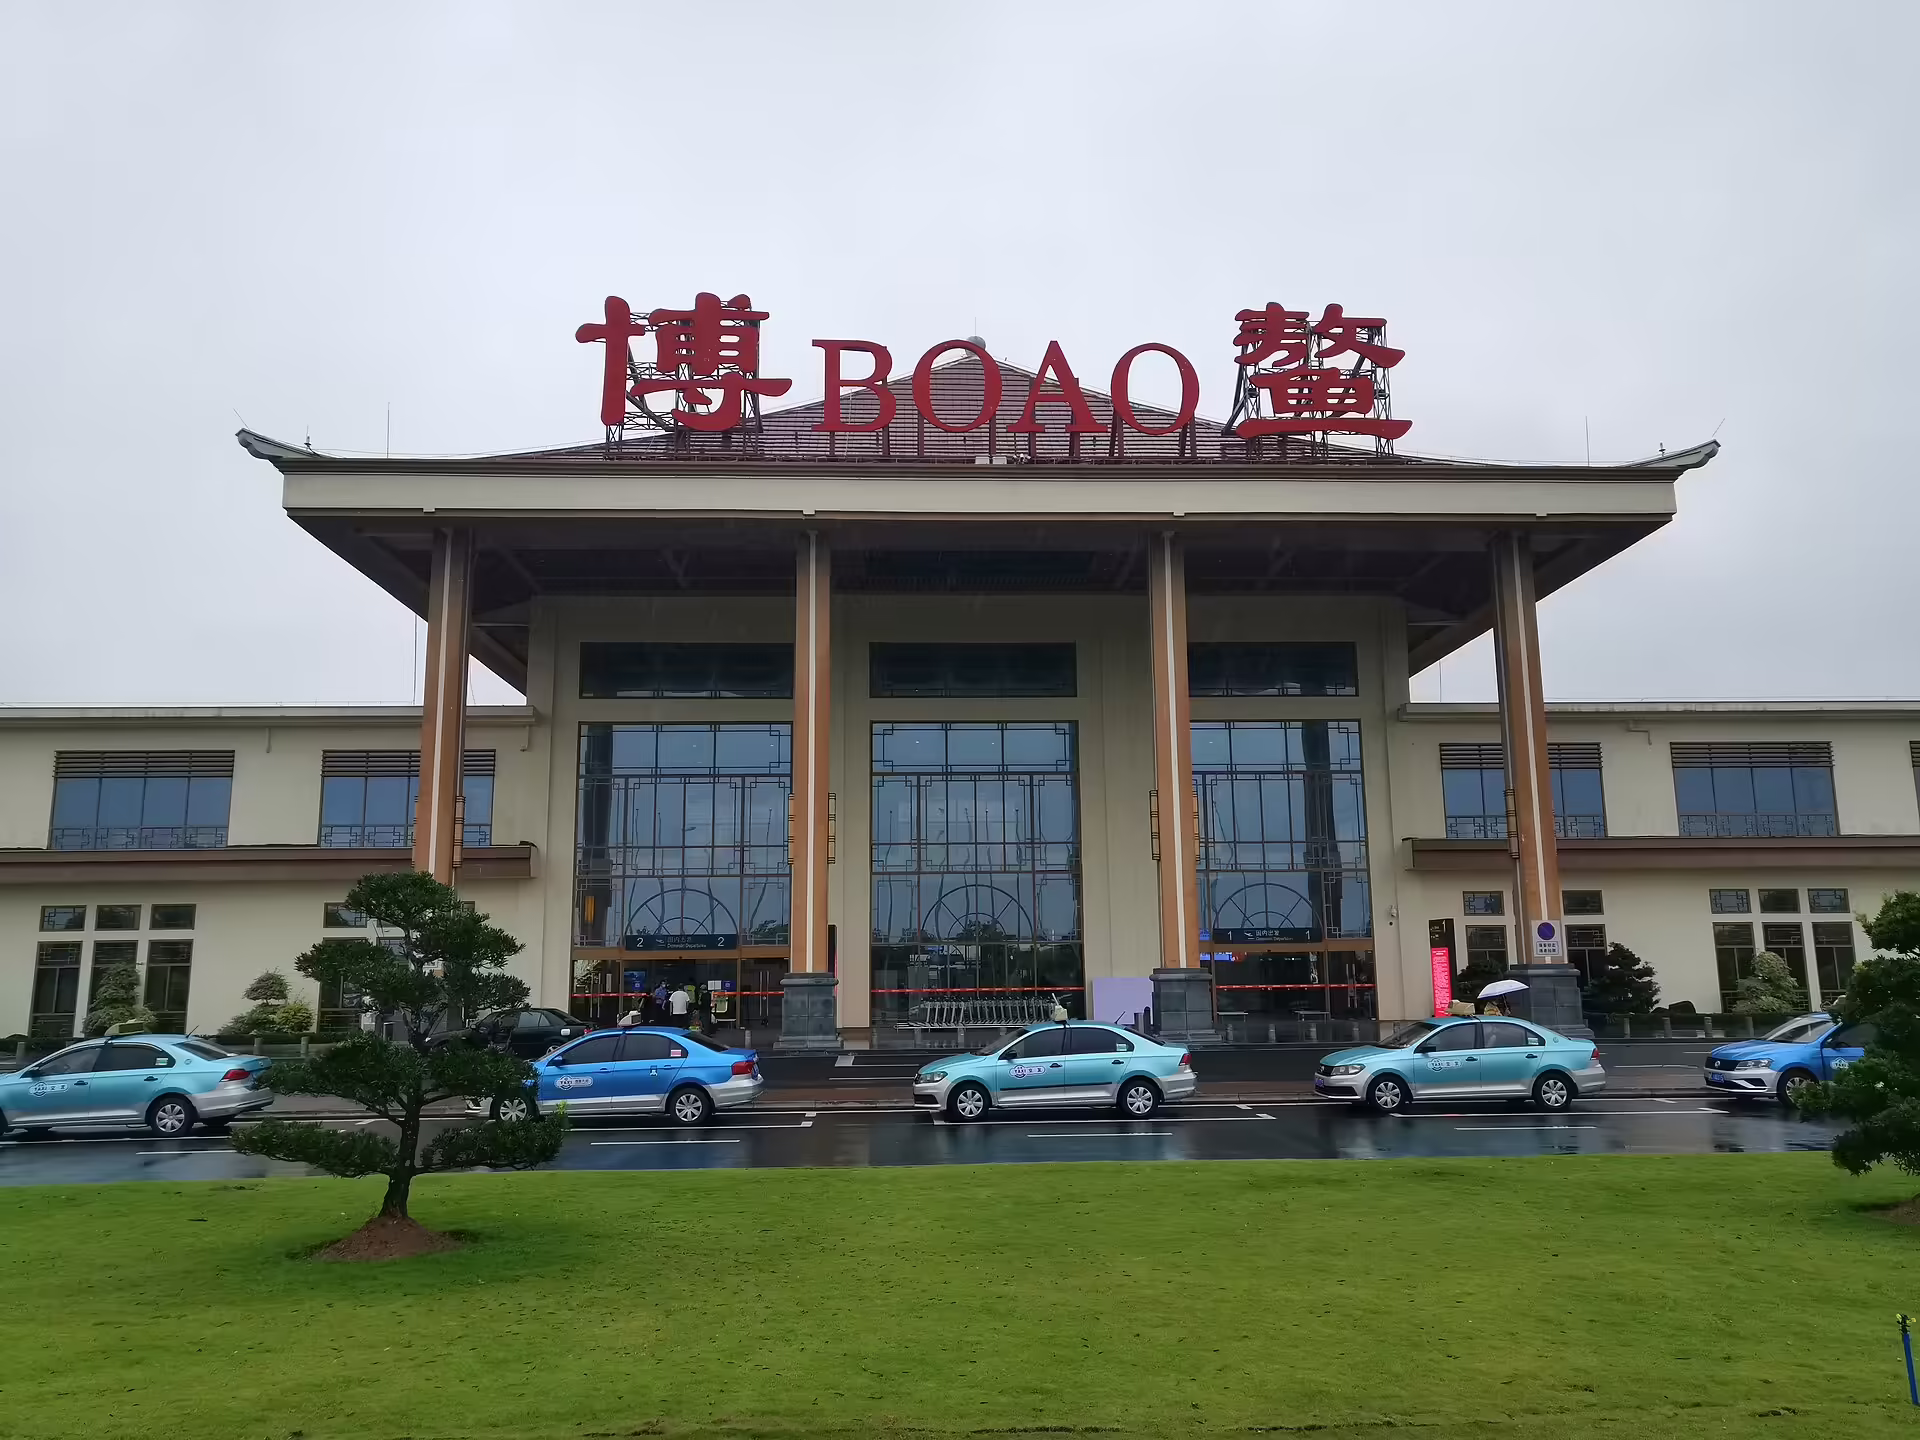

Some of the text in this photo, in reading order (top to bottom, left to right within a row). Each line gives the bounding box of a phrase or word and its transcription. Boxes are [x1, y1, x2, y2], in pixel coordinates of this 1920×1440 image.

[576, 294, 793, 432] 博
[1233, 303, 1412, 441] 鳌
[812, 339, 1200, 435] BOAO
[1227, 930, 1233, 941] 1
[1305, 929, 1311, 940] 1
[636, 937, 645, 948] 2
[717, 936, 726, 947] 2
